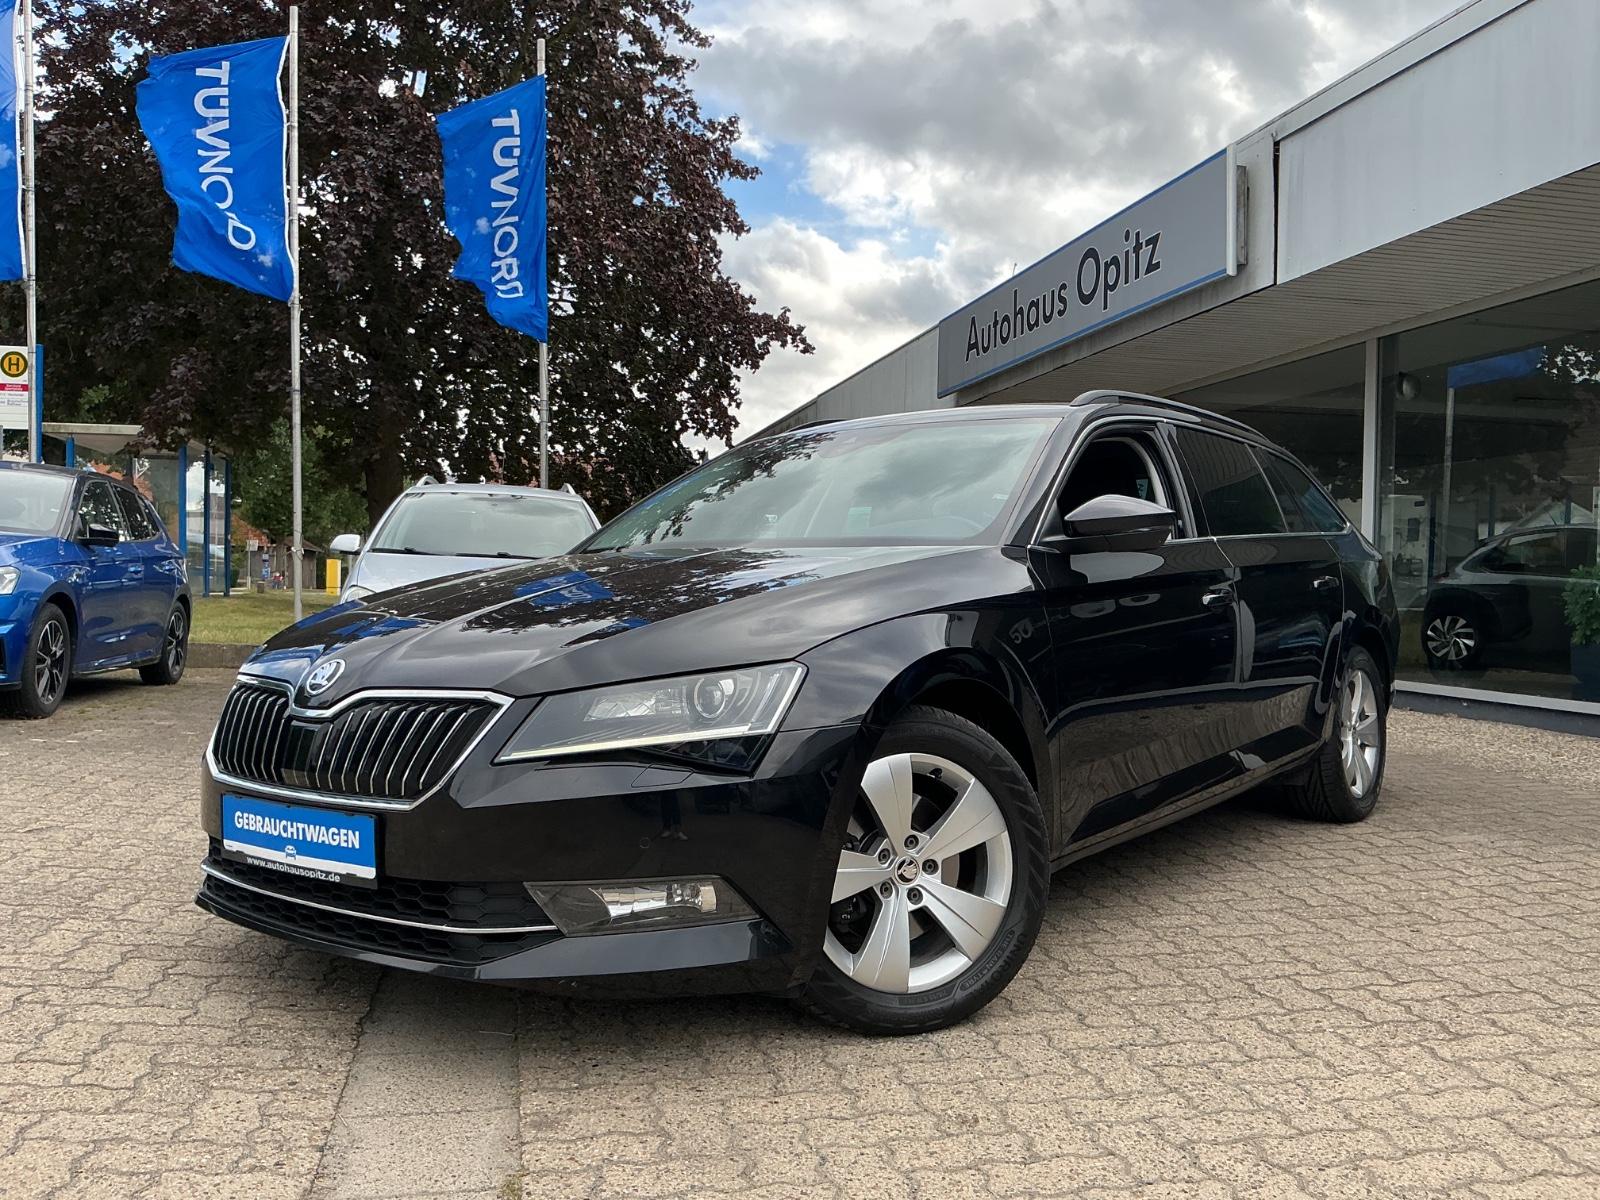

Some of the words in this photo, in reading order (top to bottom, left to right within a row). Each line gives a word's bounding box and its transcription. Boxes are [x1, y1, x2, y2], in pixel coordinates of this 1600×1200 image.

[965, 281, 1068, 363] Autohaus
[1076, 229, 1162, 311] Opitz
[8, 357, 20, 371] H
[234, 810, 360, 849] GEBRAUCHTWAGEN
[247, 856, 341, 882] www.autohausopitz.de
